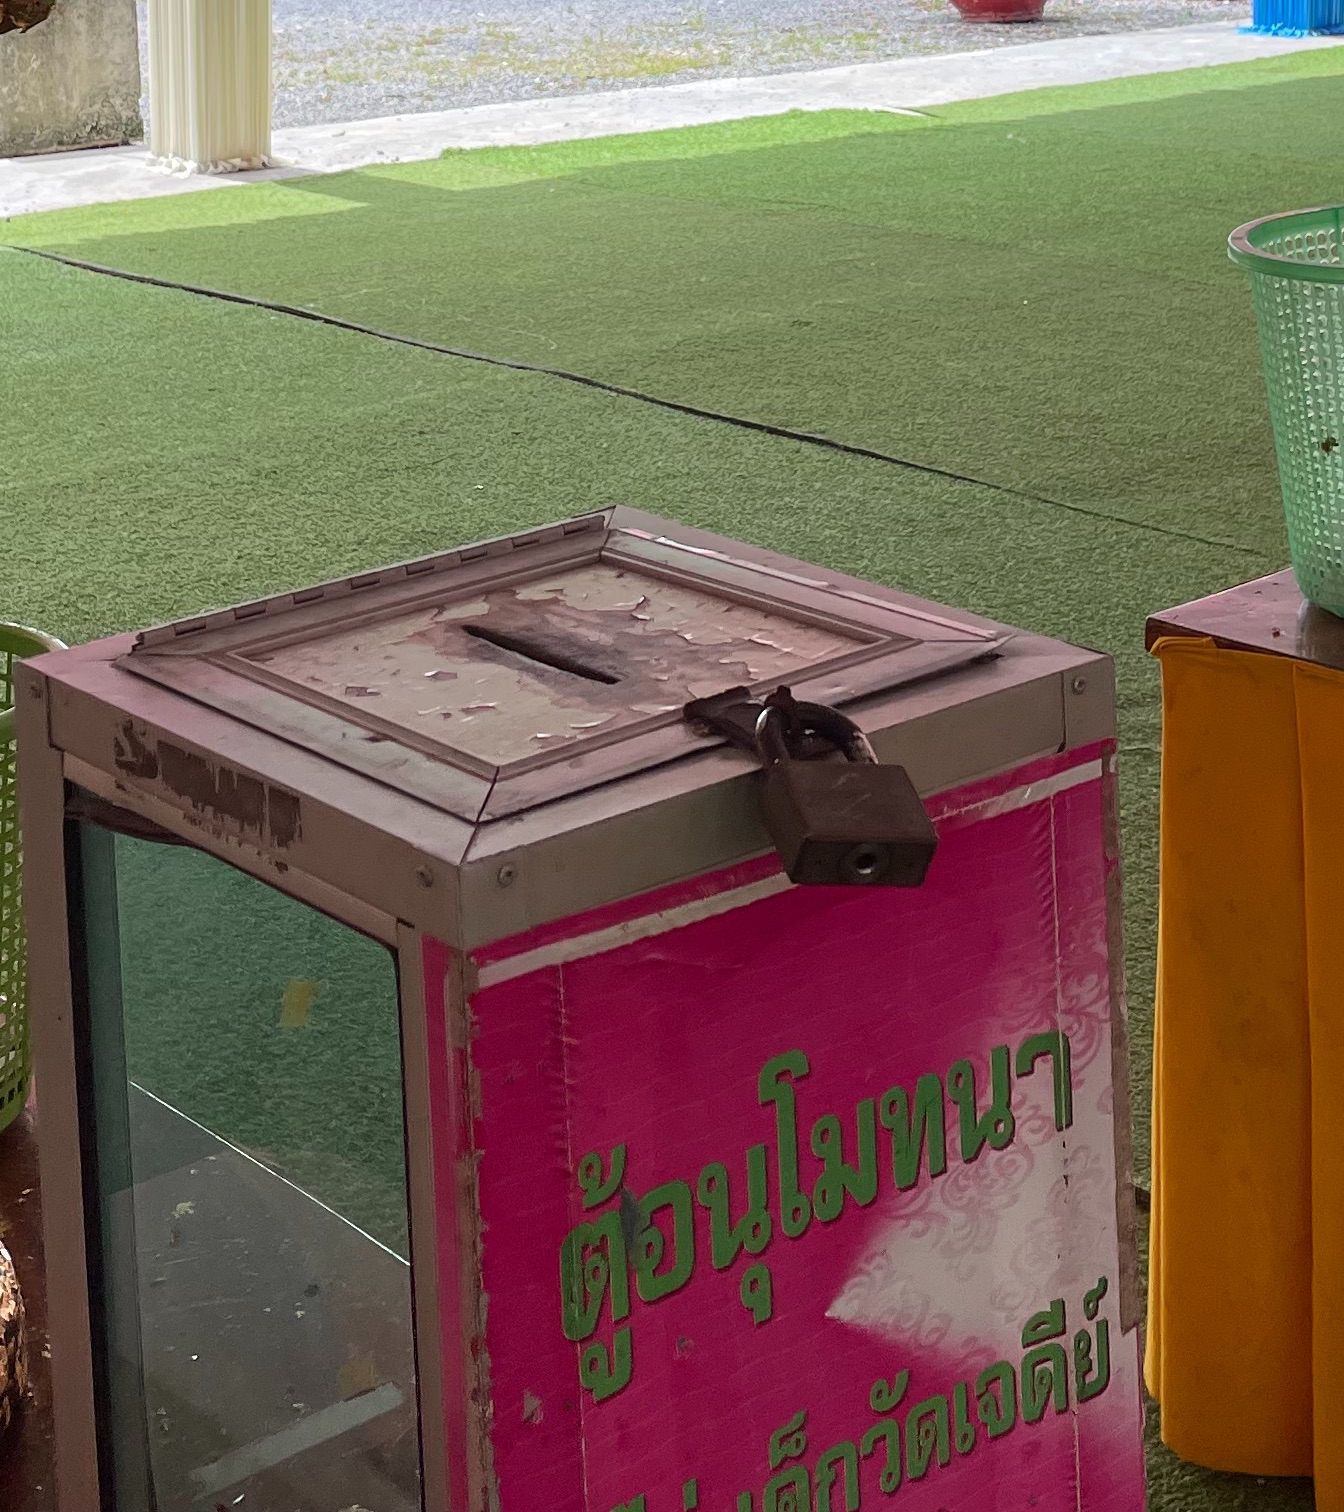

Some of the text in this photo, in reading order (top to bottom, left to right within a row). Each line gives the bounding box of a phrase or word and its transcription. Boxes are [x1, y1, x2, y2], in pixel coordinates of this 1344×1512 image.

[560, 1029, 1072, 1403] ตู้อนุโมทนา
